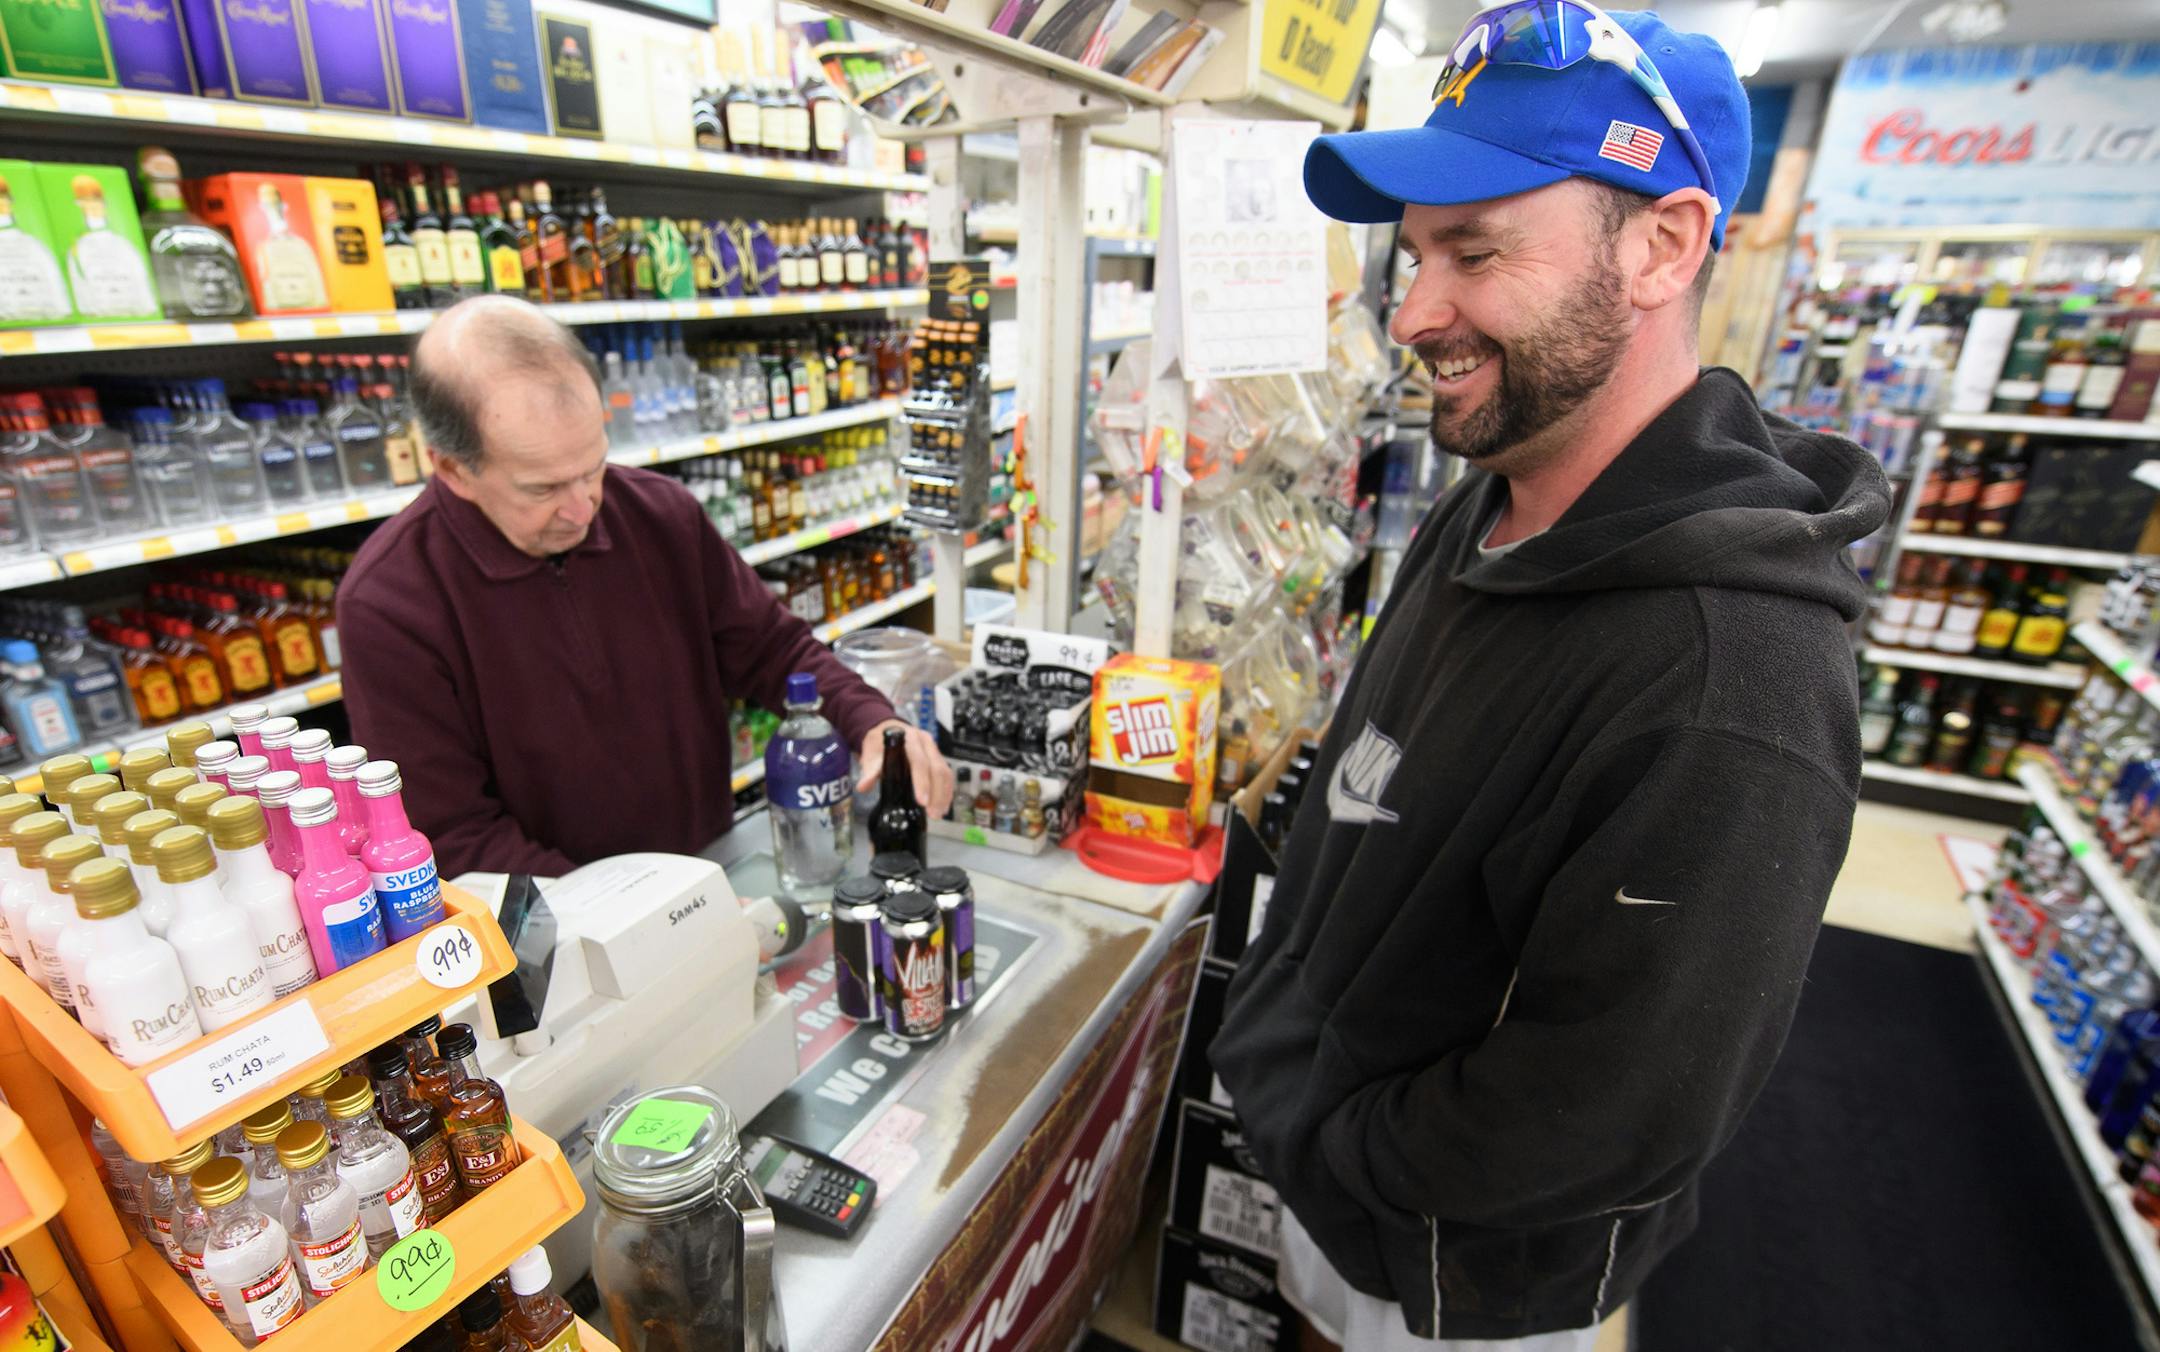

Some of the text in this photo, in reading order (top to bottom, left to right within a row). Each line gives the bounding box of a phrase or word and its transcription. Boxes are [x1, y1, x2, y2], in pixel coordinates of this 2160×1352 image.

[1860, 106, 2038, 166] Coors
[208, 1034, 271, 1072] RUM CHATA
[211, 1057, 264, 1093] $1.49
[816, 1057, 887, 1106] We
[423, 1158, 451, 1187] E&J
[465, 1151, 496, 1170] E&J
[468, 1171, 505, 1185] BRANDY
